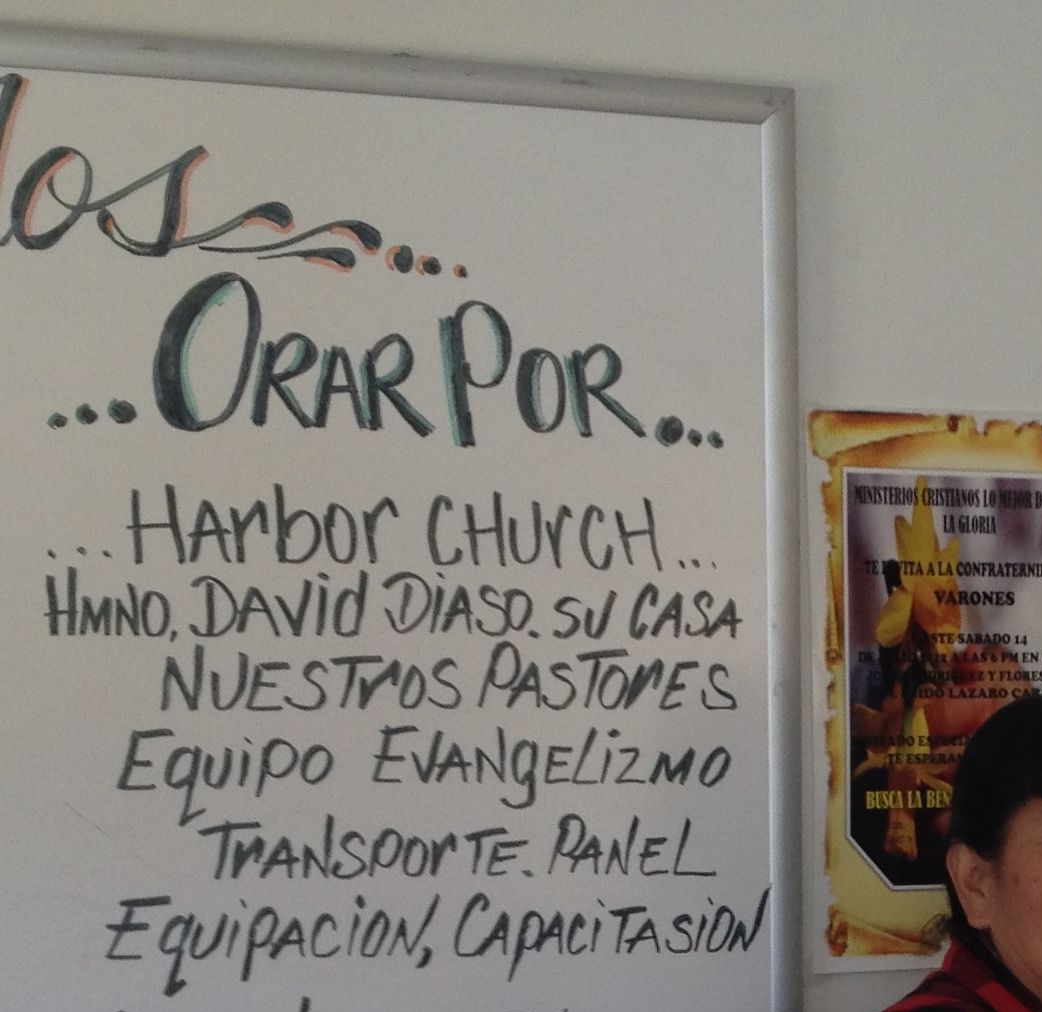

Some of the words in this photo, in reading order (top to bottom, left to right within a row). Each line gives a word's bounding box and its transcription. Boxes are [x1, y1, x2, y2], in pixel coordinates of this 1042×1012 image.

[854, 485, 919, 506] MINISTERIOS
[922, 487, 980, 508] CRISTIANOS
[983, 489, 997, 508] LO
[943, 515, 955, 533] LA
[958, 515, 997, 534] GLORIA
[865, 560, 879, 575] TE
[926, 561, 936, 576] A
[938, 561, 954, 576] LA
[934, 590, 1015, 606] VARONES
[629, 582, 742, 639] CASA
[924, 633, 955, 645] STE
[958, 633, 1010, 645] SABADO
[1015, 634, 1028, 646] 14
[1000, 652, 1018, 663] PM
[1022, 652, 1039, 663] EN
[949, 688, 1007, 699] LAZARO
[887, 754, 903, 765] TE
[866, 791, 903, 809] BUSCA
[907, 791, 923, 809] LA
[926, 791, 951, 809] BEN
[549, 812, 717, 877] PANEL
